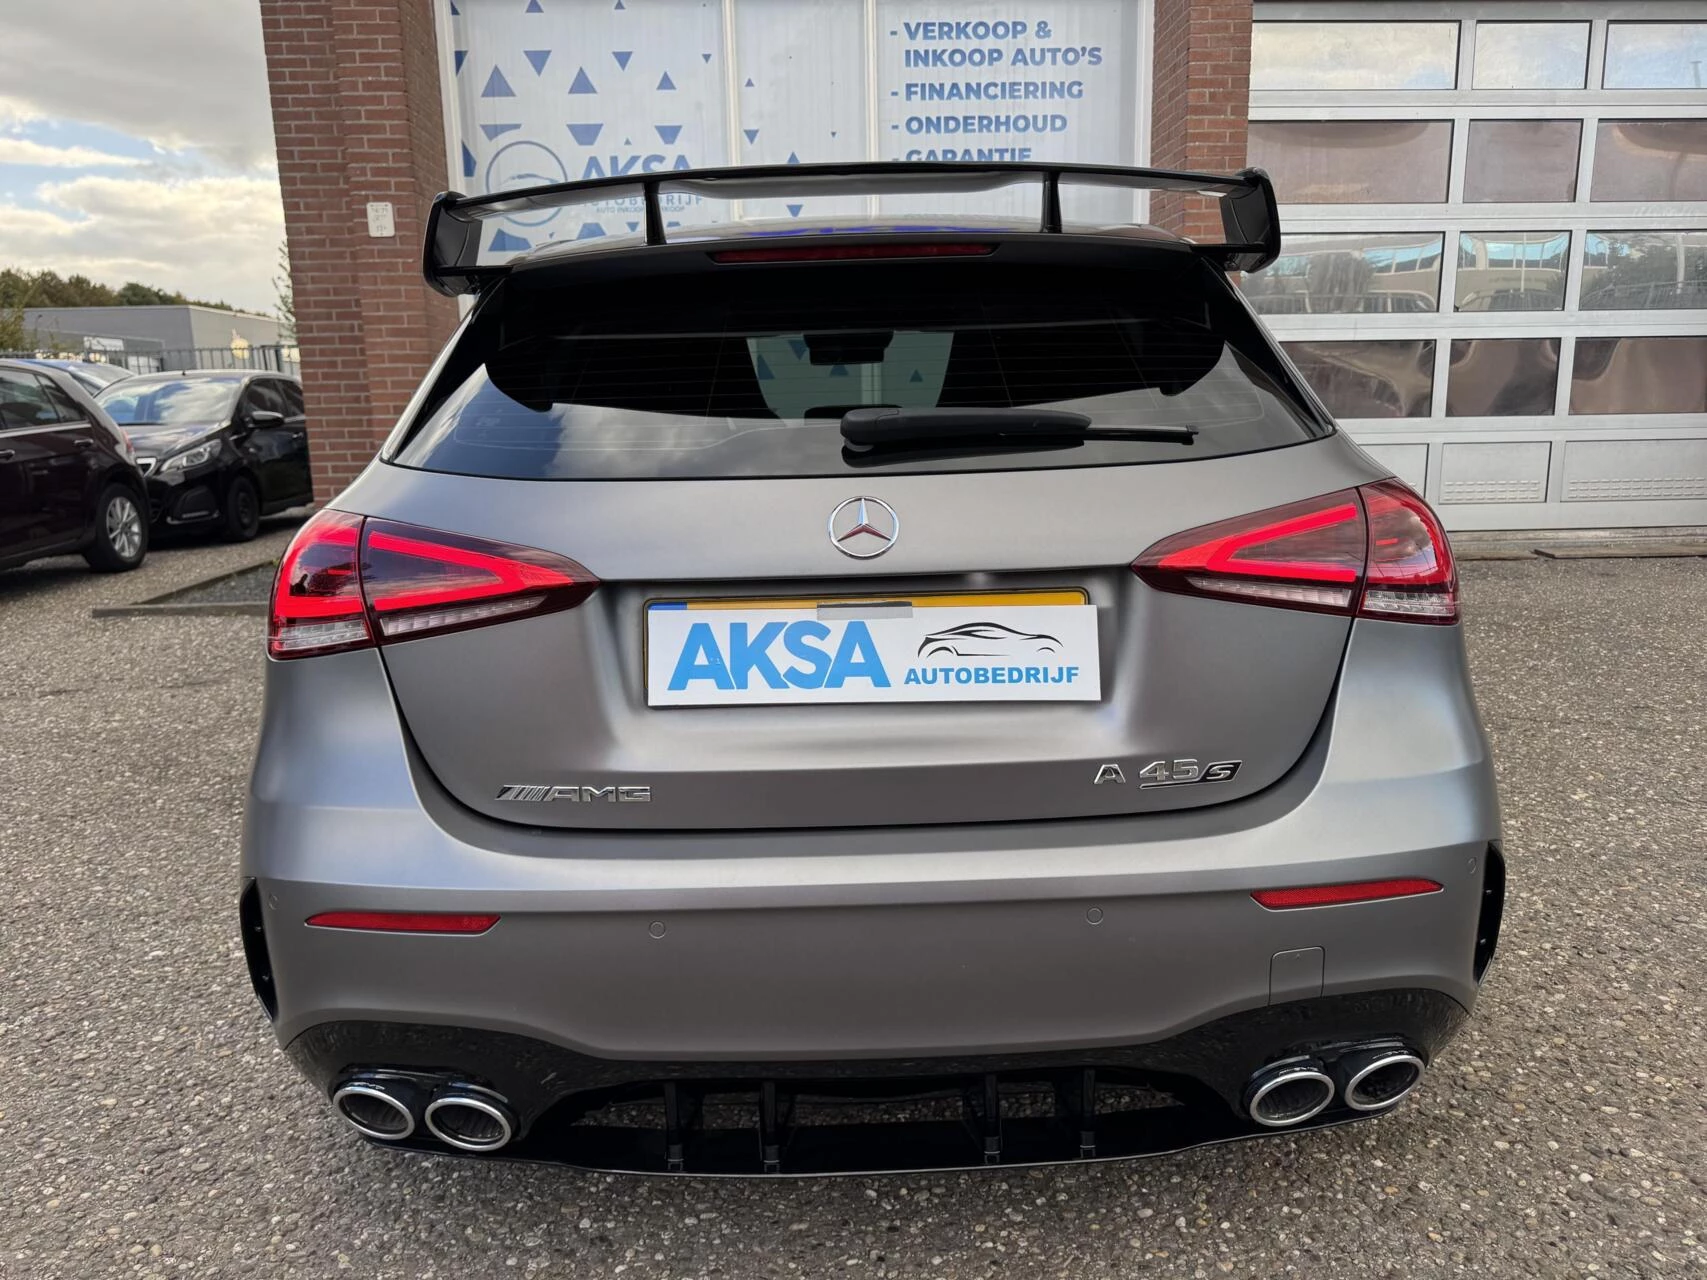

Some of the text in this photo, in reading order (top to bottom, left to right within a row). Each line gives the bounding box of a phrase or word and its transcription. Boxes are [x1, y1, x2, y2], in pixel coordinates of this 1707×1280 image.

[904, 21, 1027, 40] VERKOOP
[1035, 20, 1052, 39] &
[904, 49, 1003, 67] INKOOP
[905, 81, 1084, 100] FINANCIERING
[905, 114, 1068, 134] ONDERHOUD
[667, 621, 891, 691] AKSA
[904, 666, 1079, 685] AUTOBEDRIJF
[1094, 764, 1126, 784] A
[1139, 759, 1199, 781] 45
[544, 786, 651, 802] AMG
